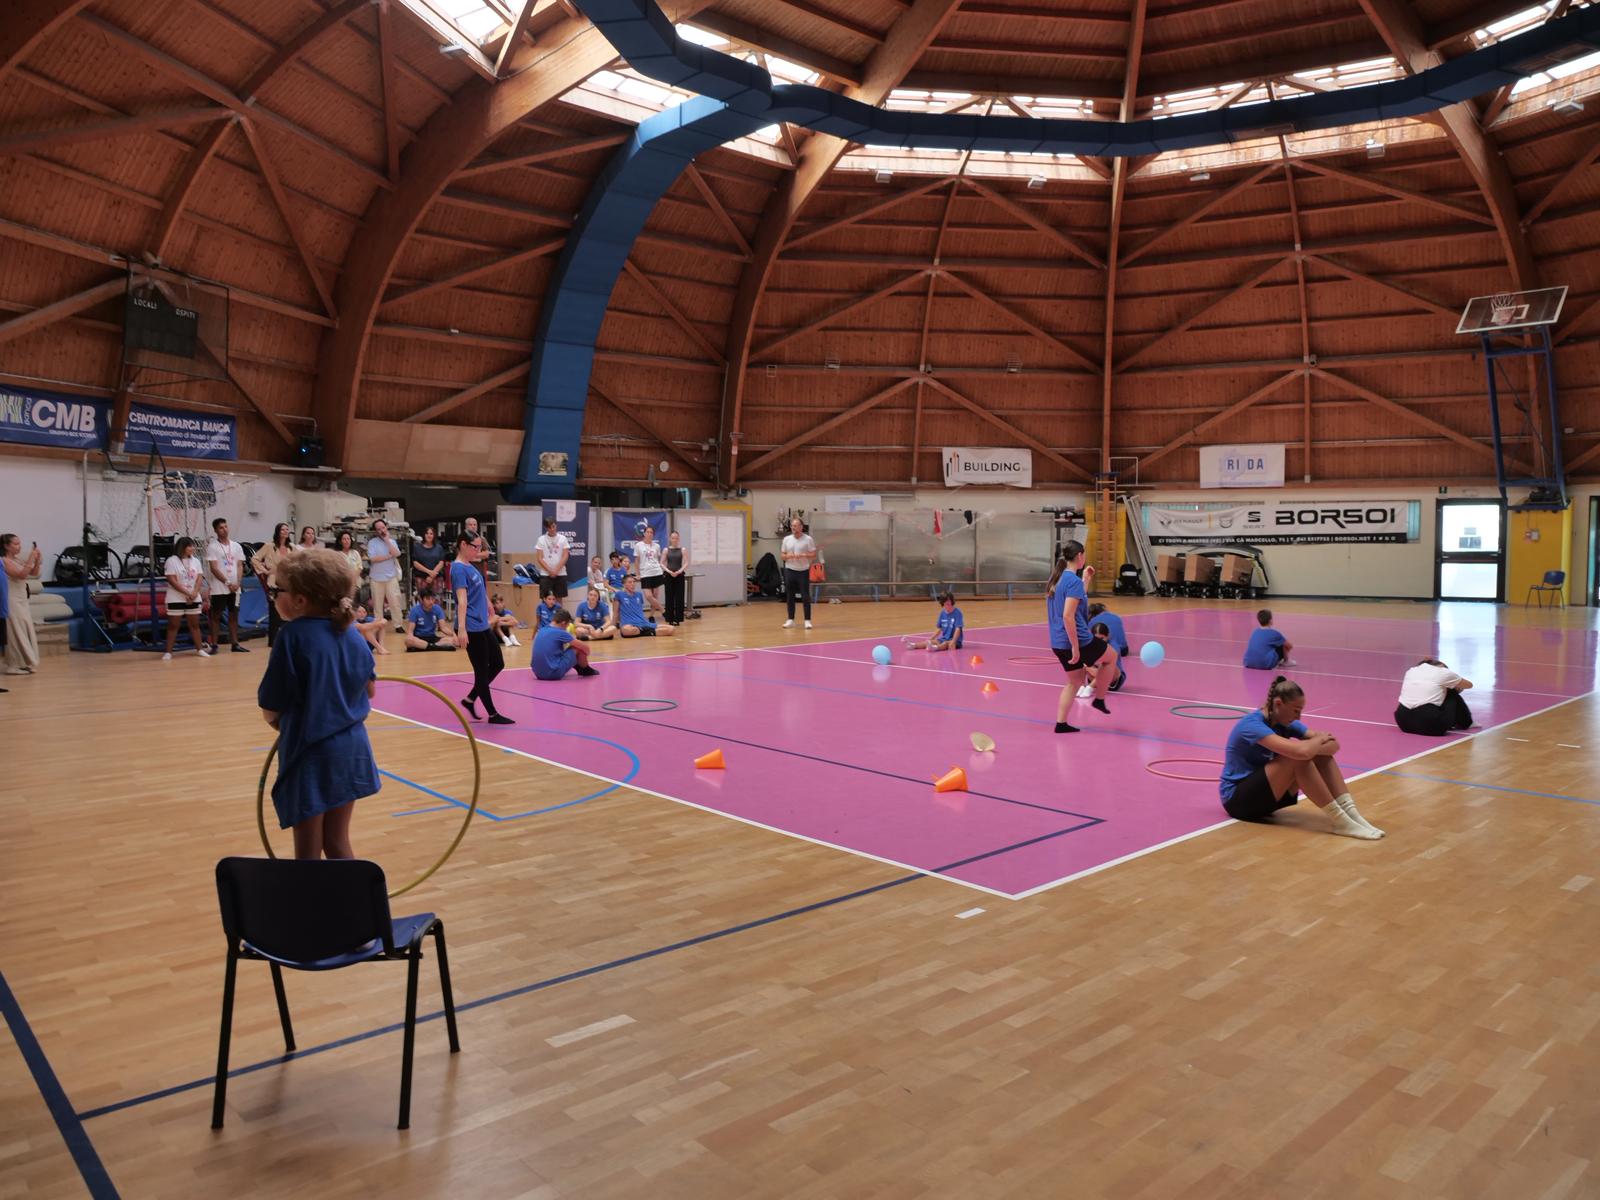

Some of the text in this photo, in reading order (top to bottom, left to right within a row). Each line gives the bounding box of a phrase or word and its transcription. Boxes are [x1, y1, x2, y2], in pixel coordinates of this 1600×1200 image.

[134, 298, 157, 309] LOCALI
[32, 400, 96, 432] CMB
[129, 412, 230, 433] CENTROMARCA BANCA
[964, 462, 1021, 472] BUILDING
[1275, 508, 1395, 528] BORSOI
